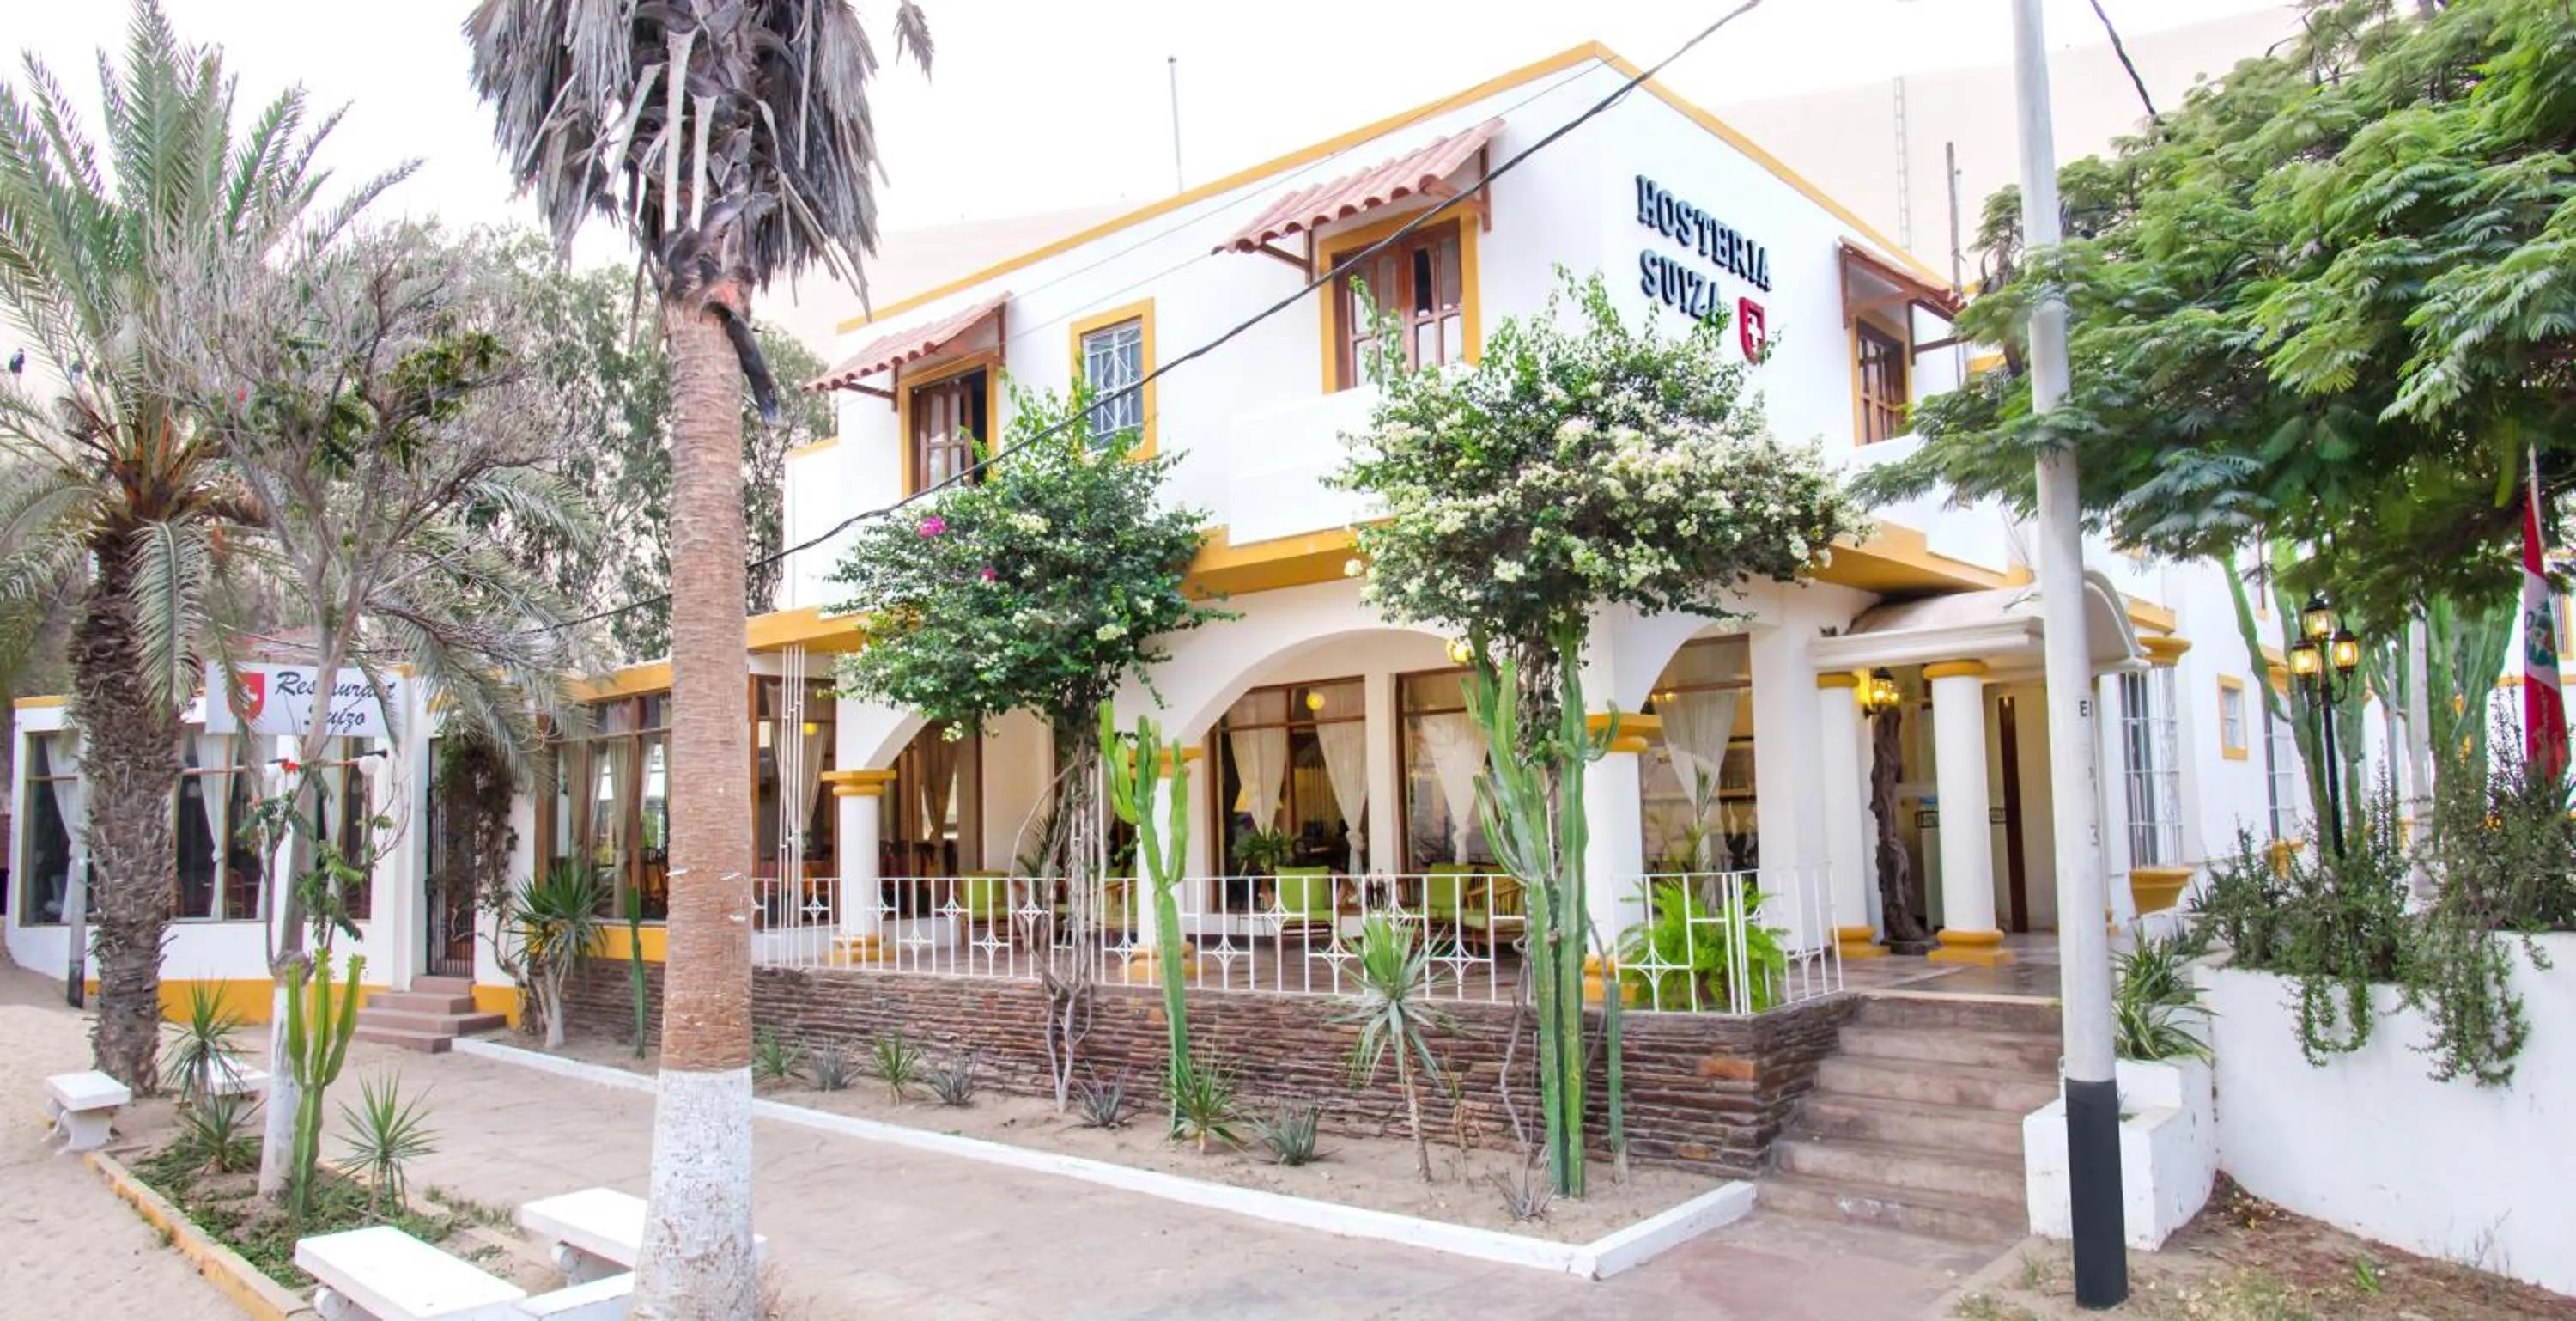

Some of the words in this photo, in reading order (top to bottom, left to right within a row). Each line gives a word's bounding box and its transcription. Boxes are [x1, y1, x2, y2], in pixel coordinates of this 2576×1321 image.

[1635, 174, 1771, 293] HOSTERIA
[1639, 248, 1721, 325] SUIZA
[274, 671, 397, 698] Resurat
[304, 704, 365, 734] uizo
